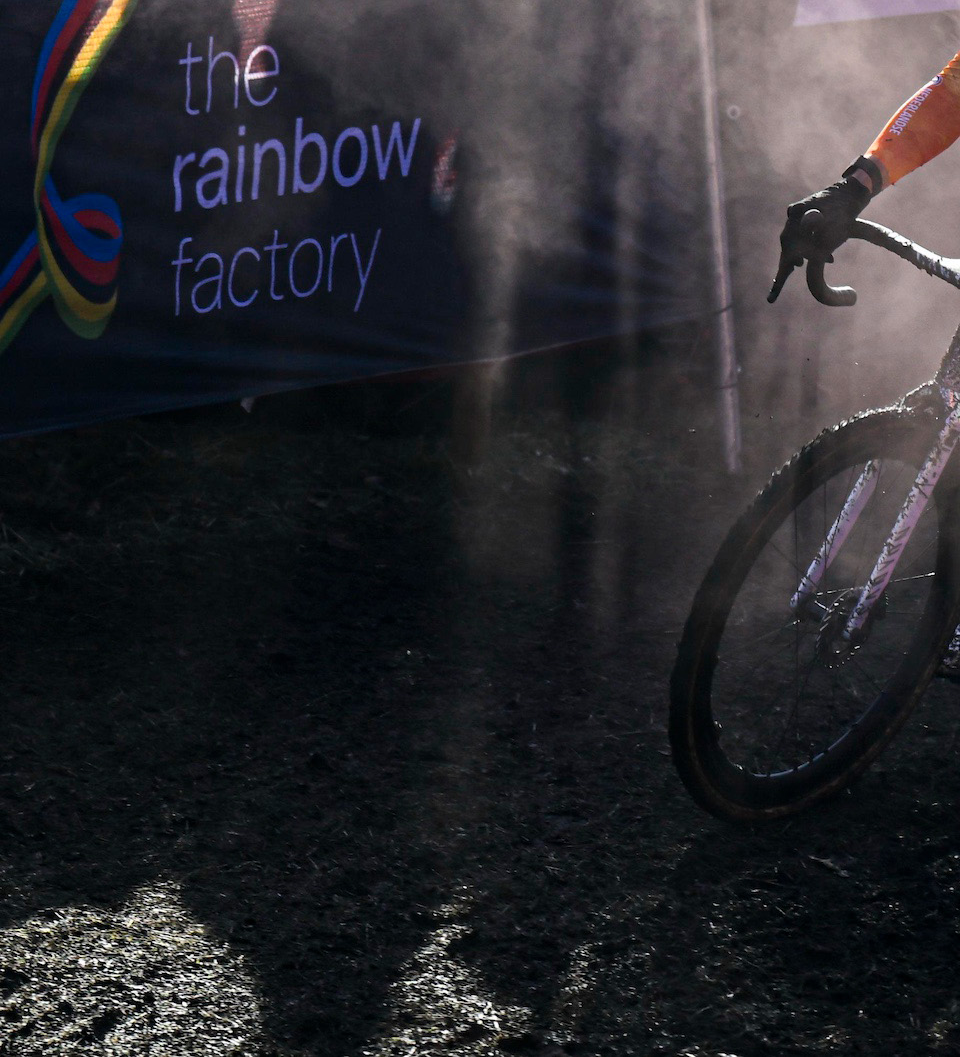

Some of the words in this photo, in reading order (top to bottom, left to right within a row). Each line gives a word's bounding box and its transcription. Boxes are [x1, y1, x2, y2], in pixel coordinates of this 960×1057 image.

[179, 36, 281, 116] the
[889, 88, 933, 136] NEDERLANDSE
[172, 117, 422, 212] rainbow
[171, 229, 381, 316] factory
